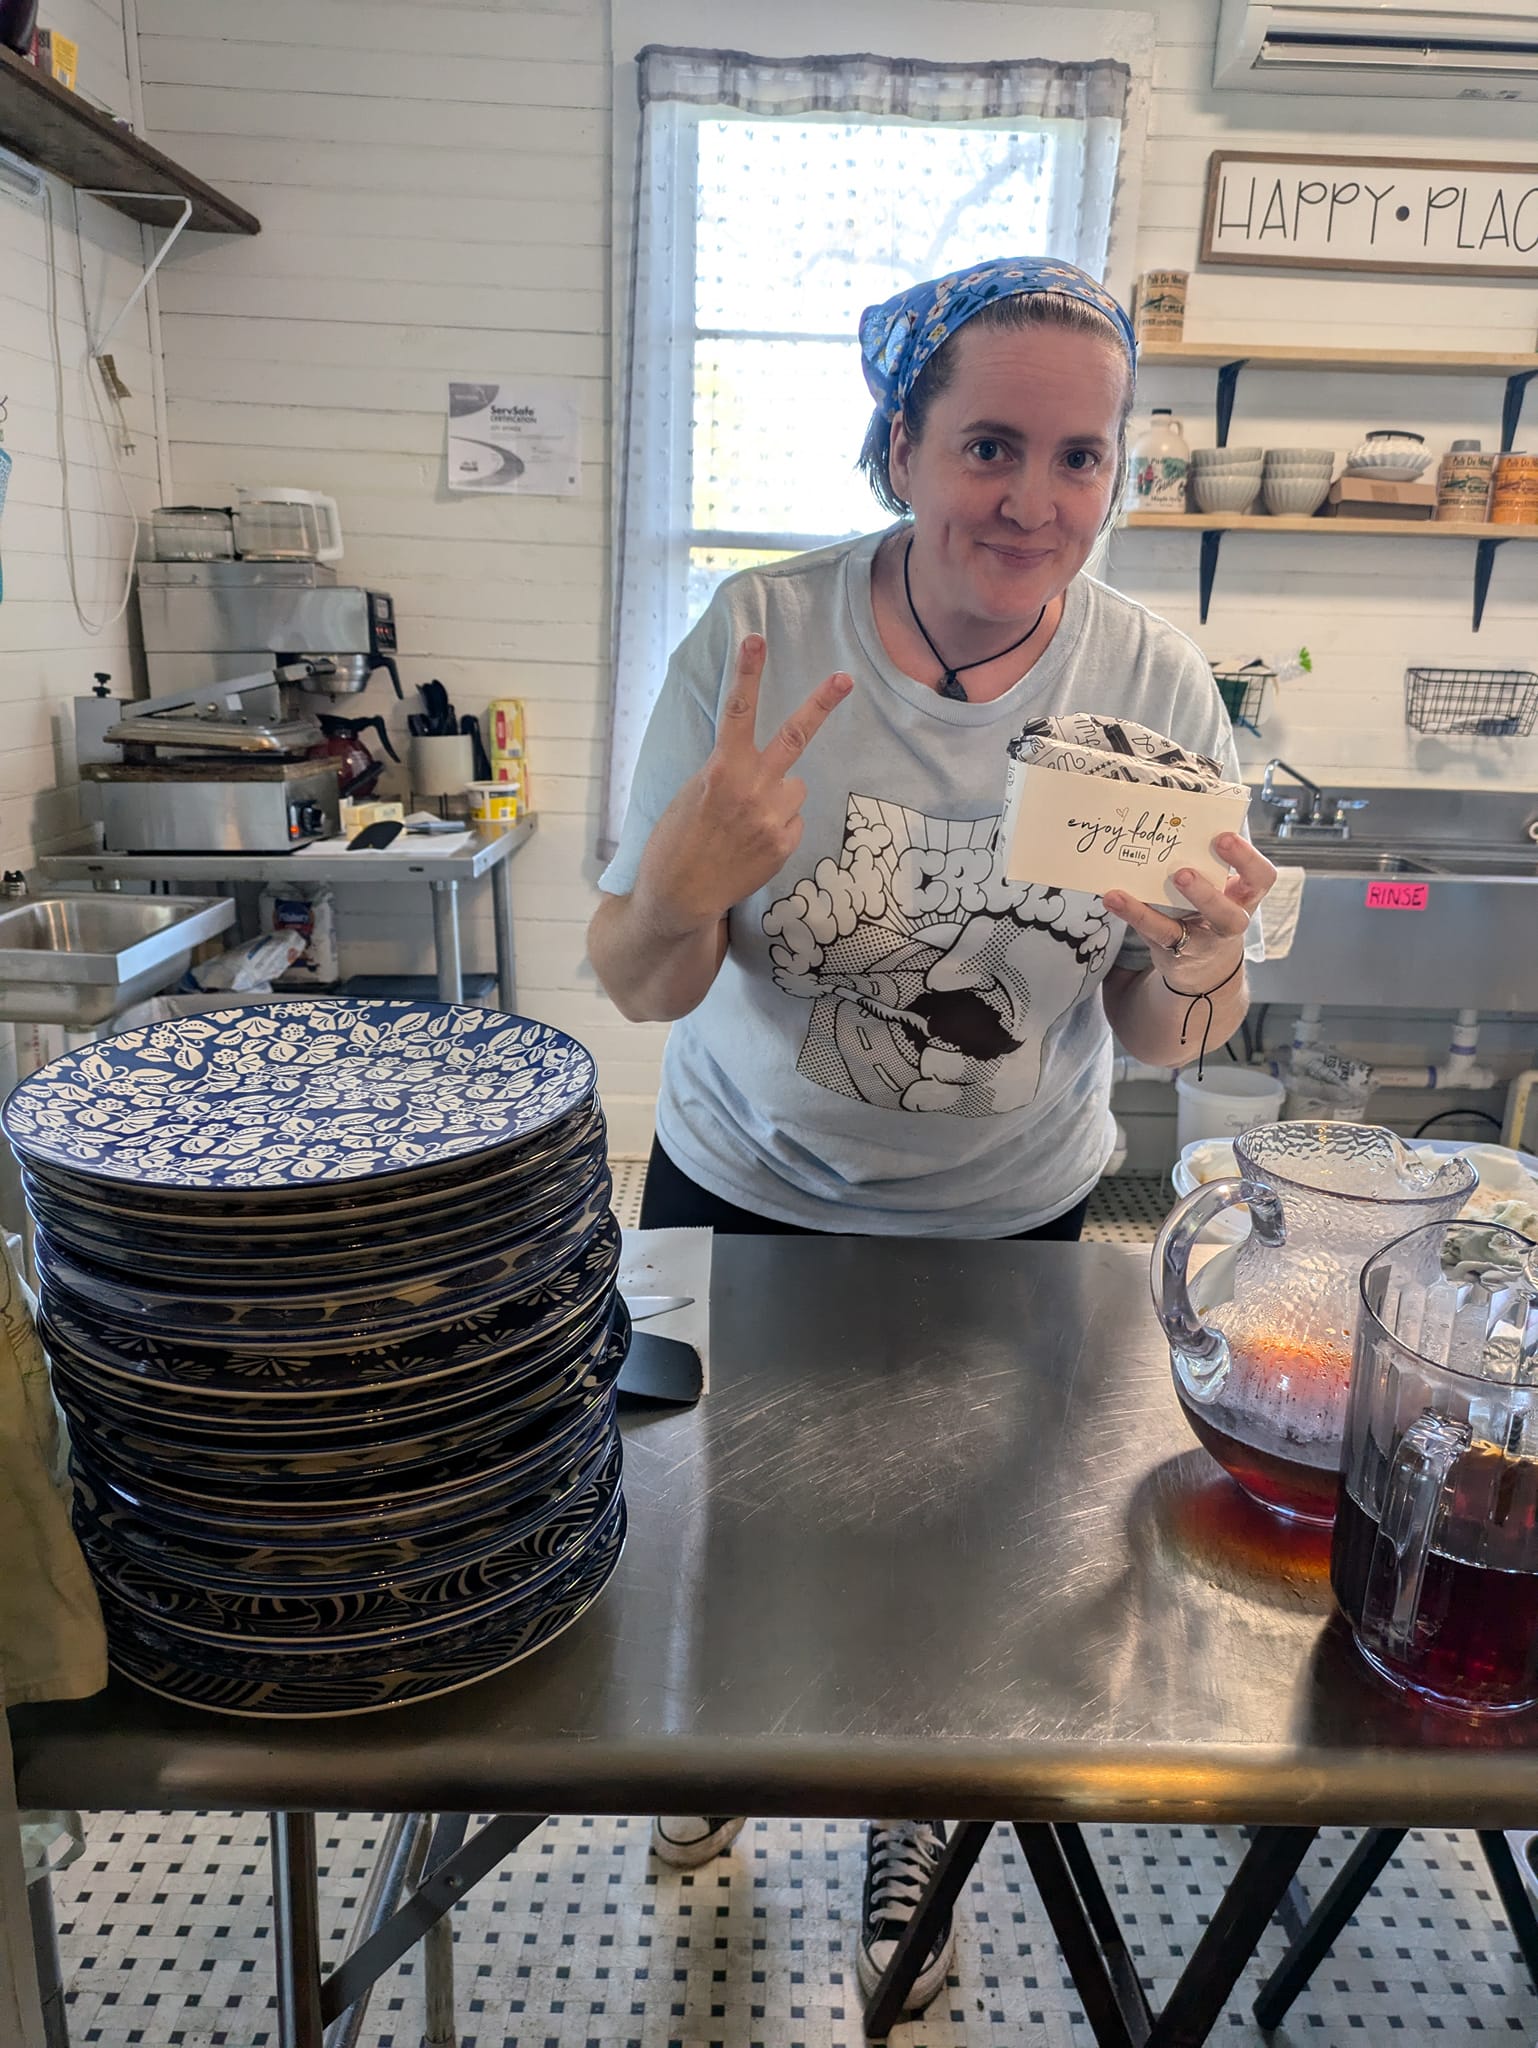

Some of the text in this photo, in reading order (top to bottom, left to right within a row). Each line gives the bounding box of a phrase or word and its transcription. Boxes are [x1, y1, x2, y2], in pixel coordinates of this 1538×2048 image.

[1218, 175, 1395, 245] HAPPY
[490, 405, 535, 416] ServSafe
[1067, 811, 1183, 863] enjoy today
[1122, 848, 1147, 860] Hello
[1369, 886, 1425, 907] RINSE
